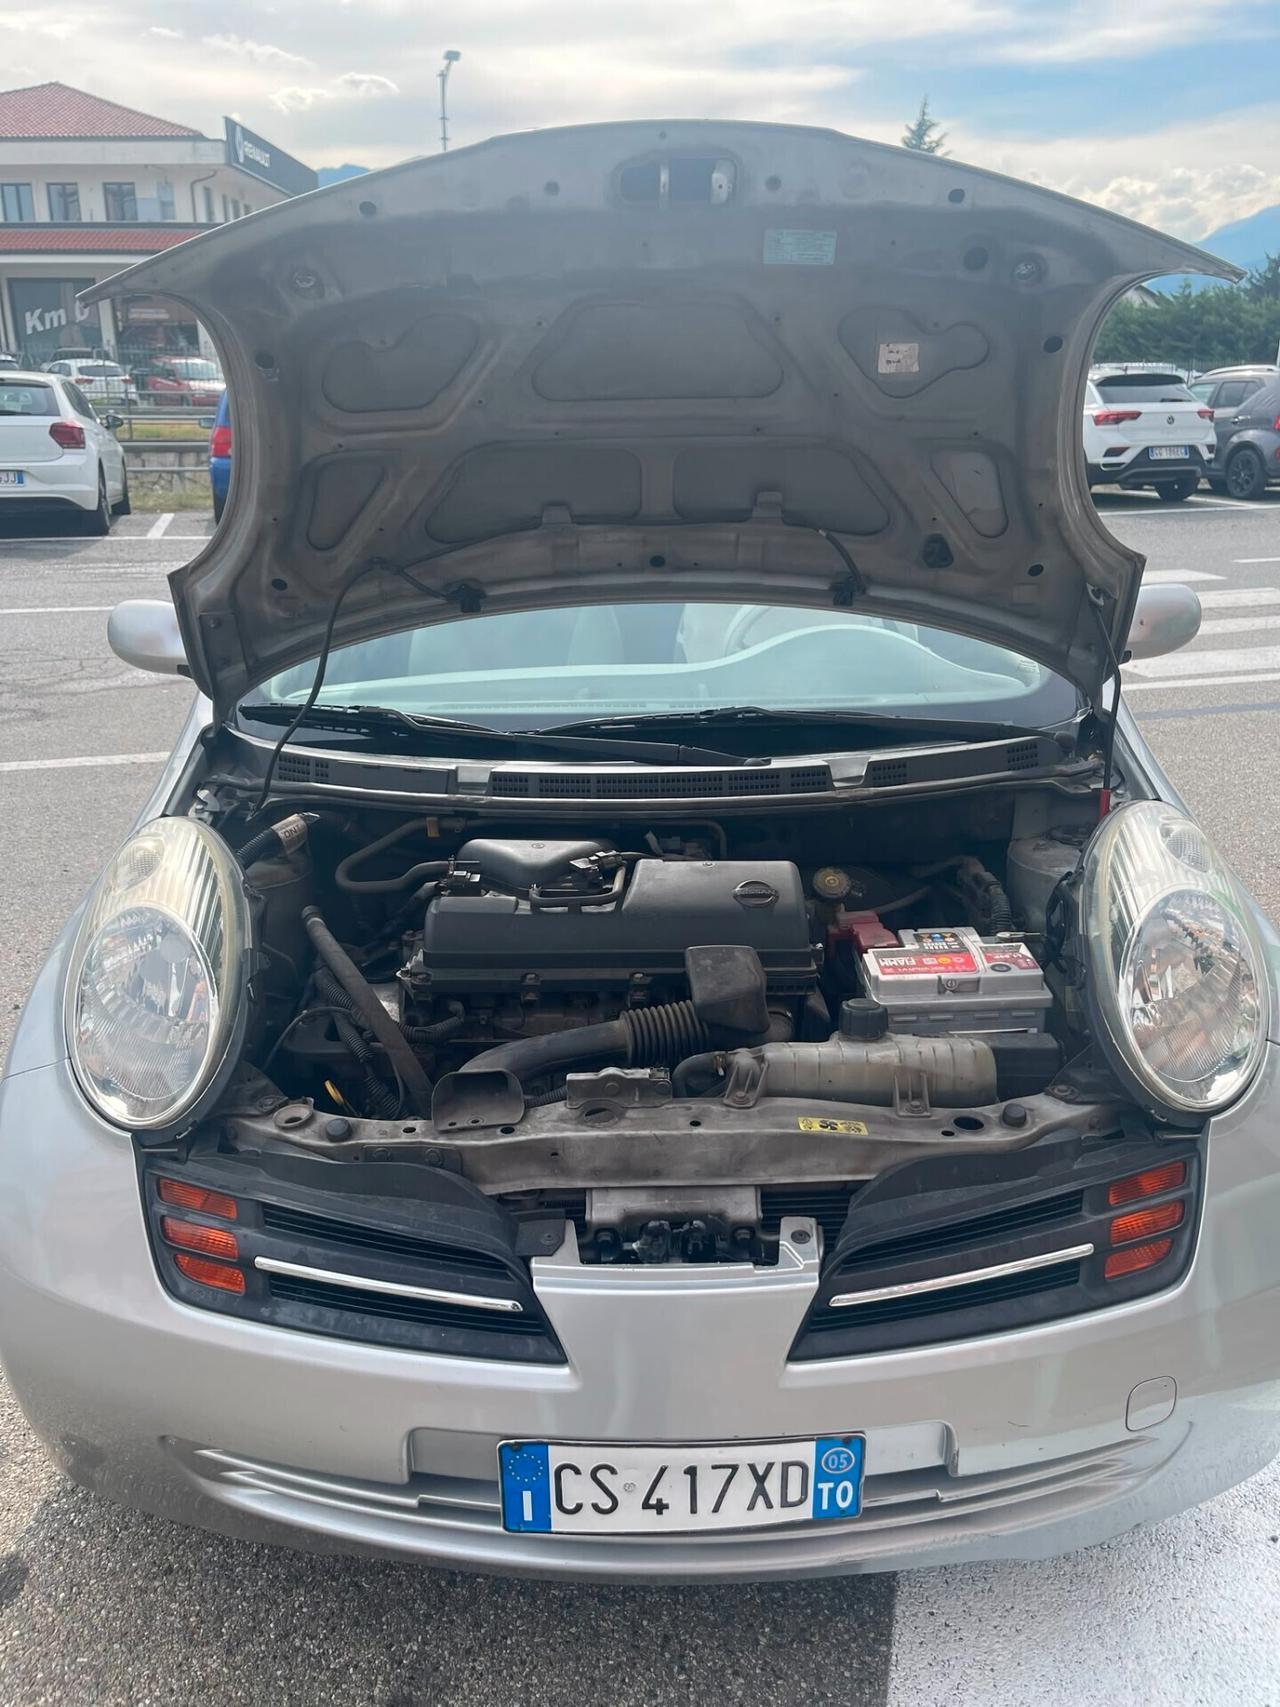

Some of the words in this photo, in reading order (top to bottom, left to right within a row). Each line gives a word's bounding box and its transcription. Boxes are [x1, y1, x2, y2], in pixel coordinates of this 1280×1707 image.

[25, 307, 67, 335] Km
[879, 957, 916, 966] FIAMM
[828, 1453, 849, 1470] 05
[554, 1462, 619, 1515] CS
[641, 1460, 810, 1515] 417XD
[818, 1480, 853, 1510] TO
